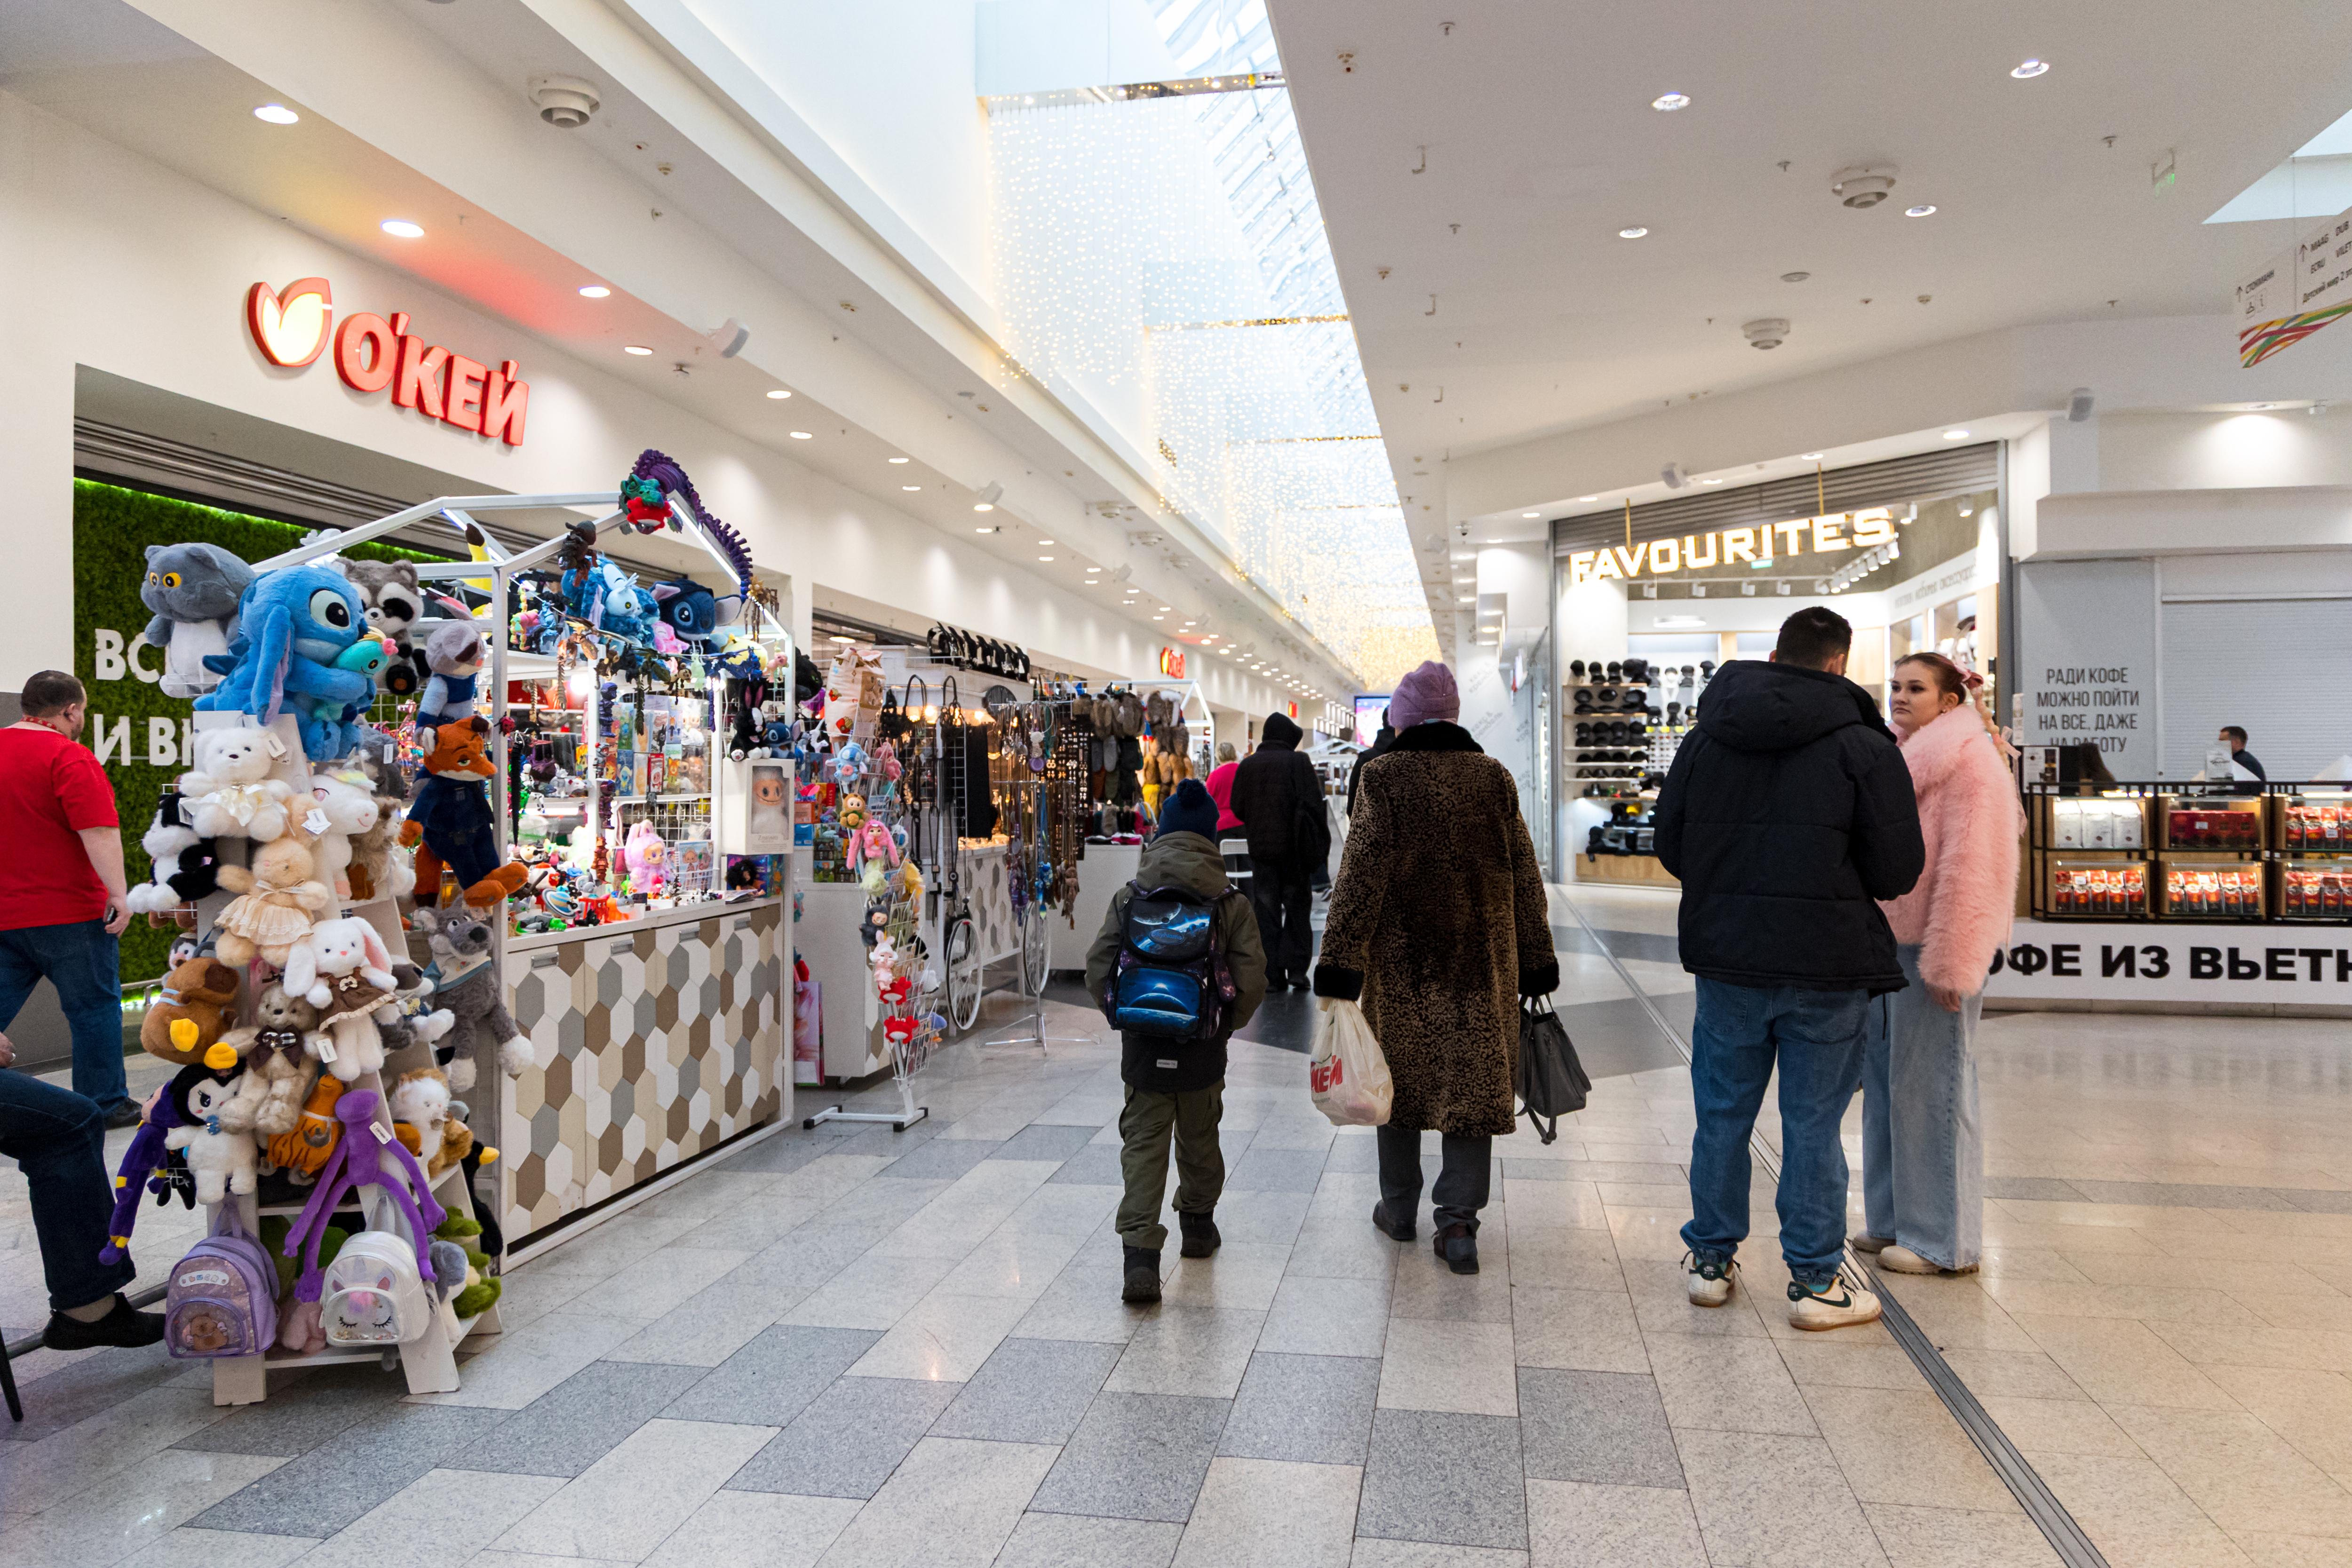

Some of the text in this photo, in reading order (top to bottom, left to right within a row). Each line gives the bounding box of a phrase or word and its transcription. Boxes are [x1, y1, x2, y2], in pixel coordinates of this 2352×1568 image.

[1569, 507, 1895, 585] FAVOURITES
[95, 628, 170, 683] ВС
[2047, 667, 2129, 685] РАДИ КОФЕ
[2036, 688, 2139, 707] МОЖНО ПОЙТИ
[2038, 714, 2058, 730] НА
[2095, 713, 2138, 731] ДАЖЕ
[94, 713, 131, 766] И
[2101, 945, 2170, 979] ИЗ
